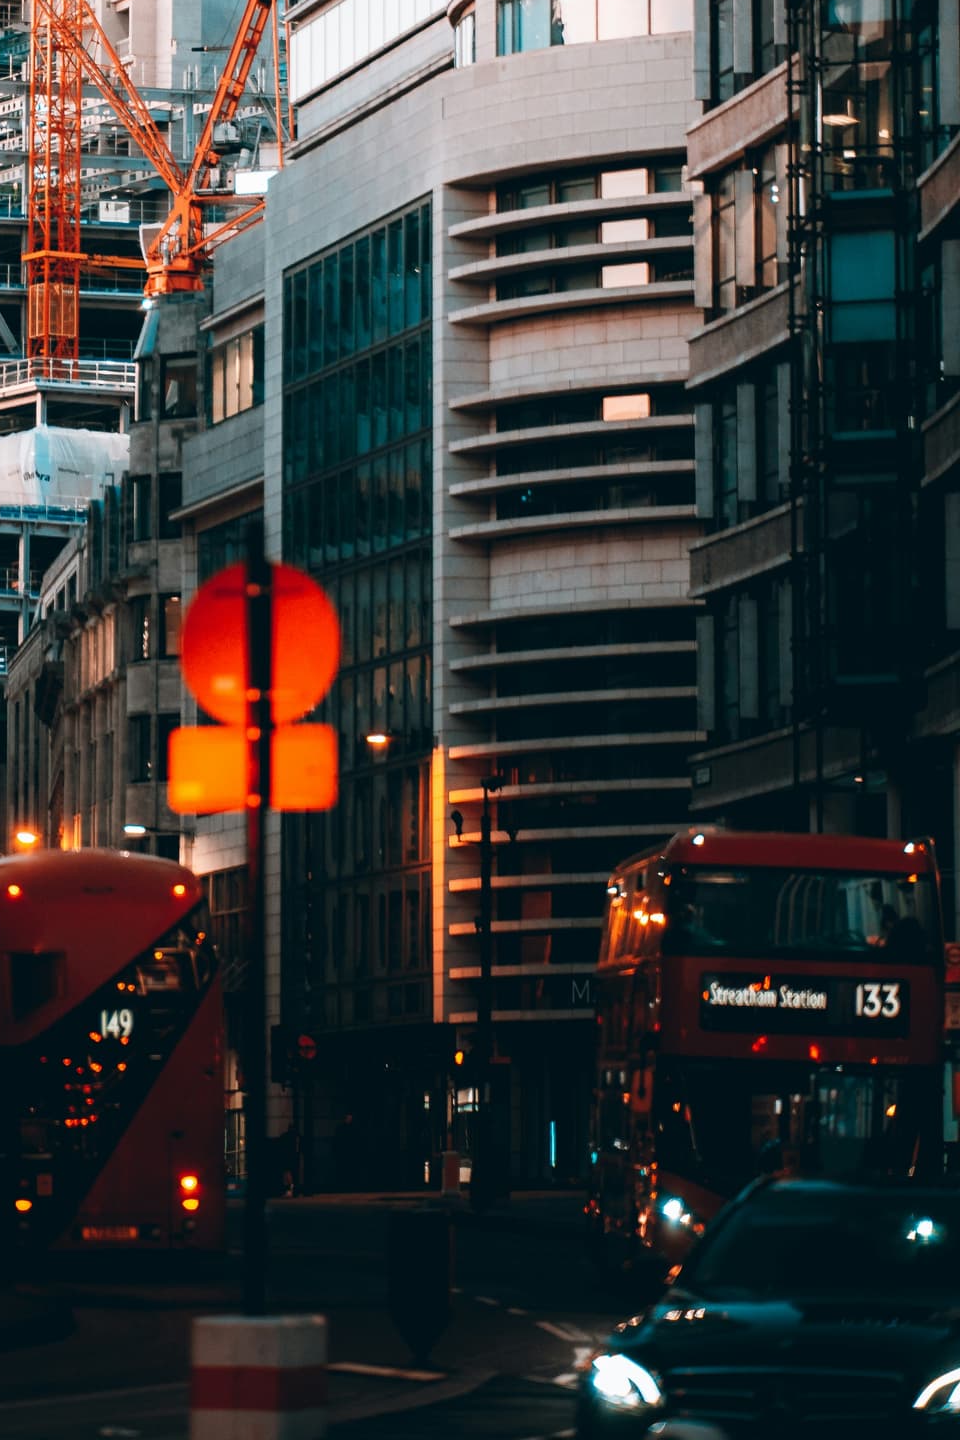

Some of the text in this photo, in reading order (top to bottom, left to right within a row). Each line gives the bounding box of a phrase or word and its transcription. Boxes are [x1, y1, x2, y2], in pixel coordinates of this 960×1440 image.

[710, 981, 901, 1018] Streatham Station 133
[101, 1009, 133, 1040] 149
